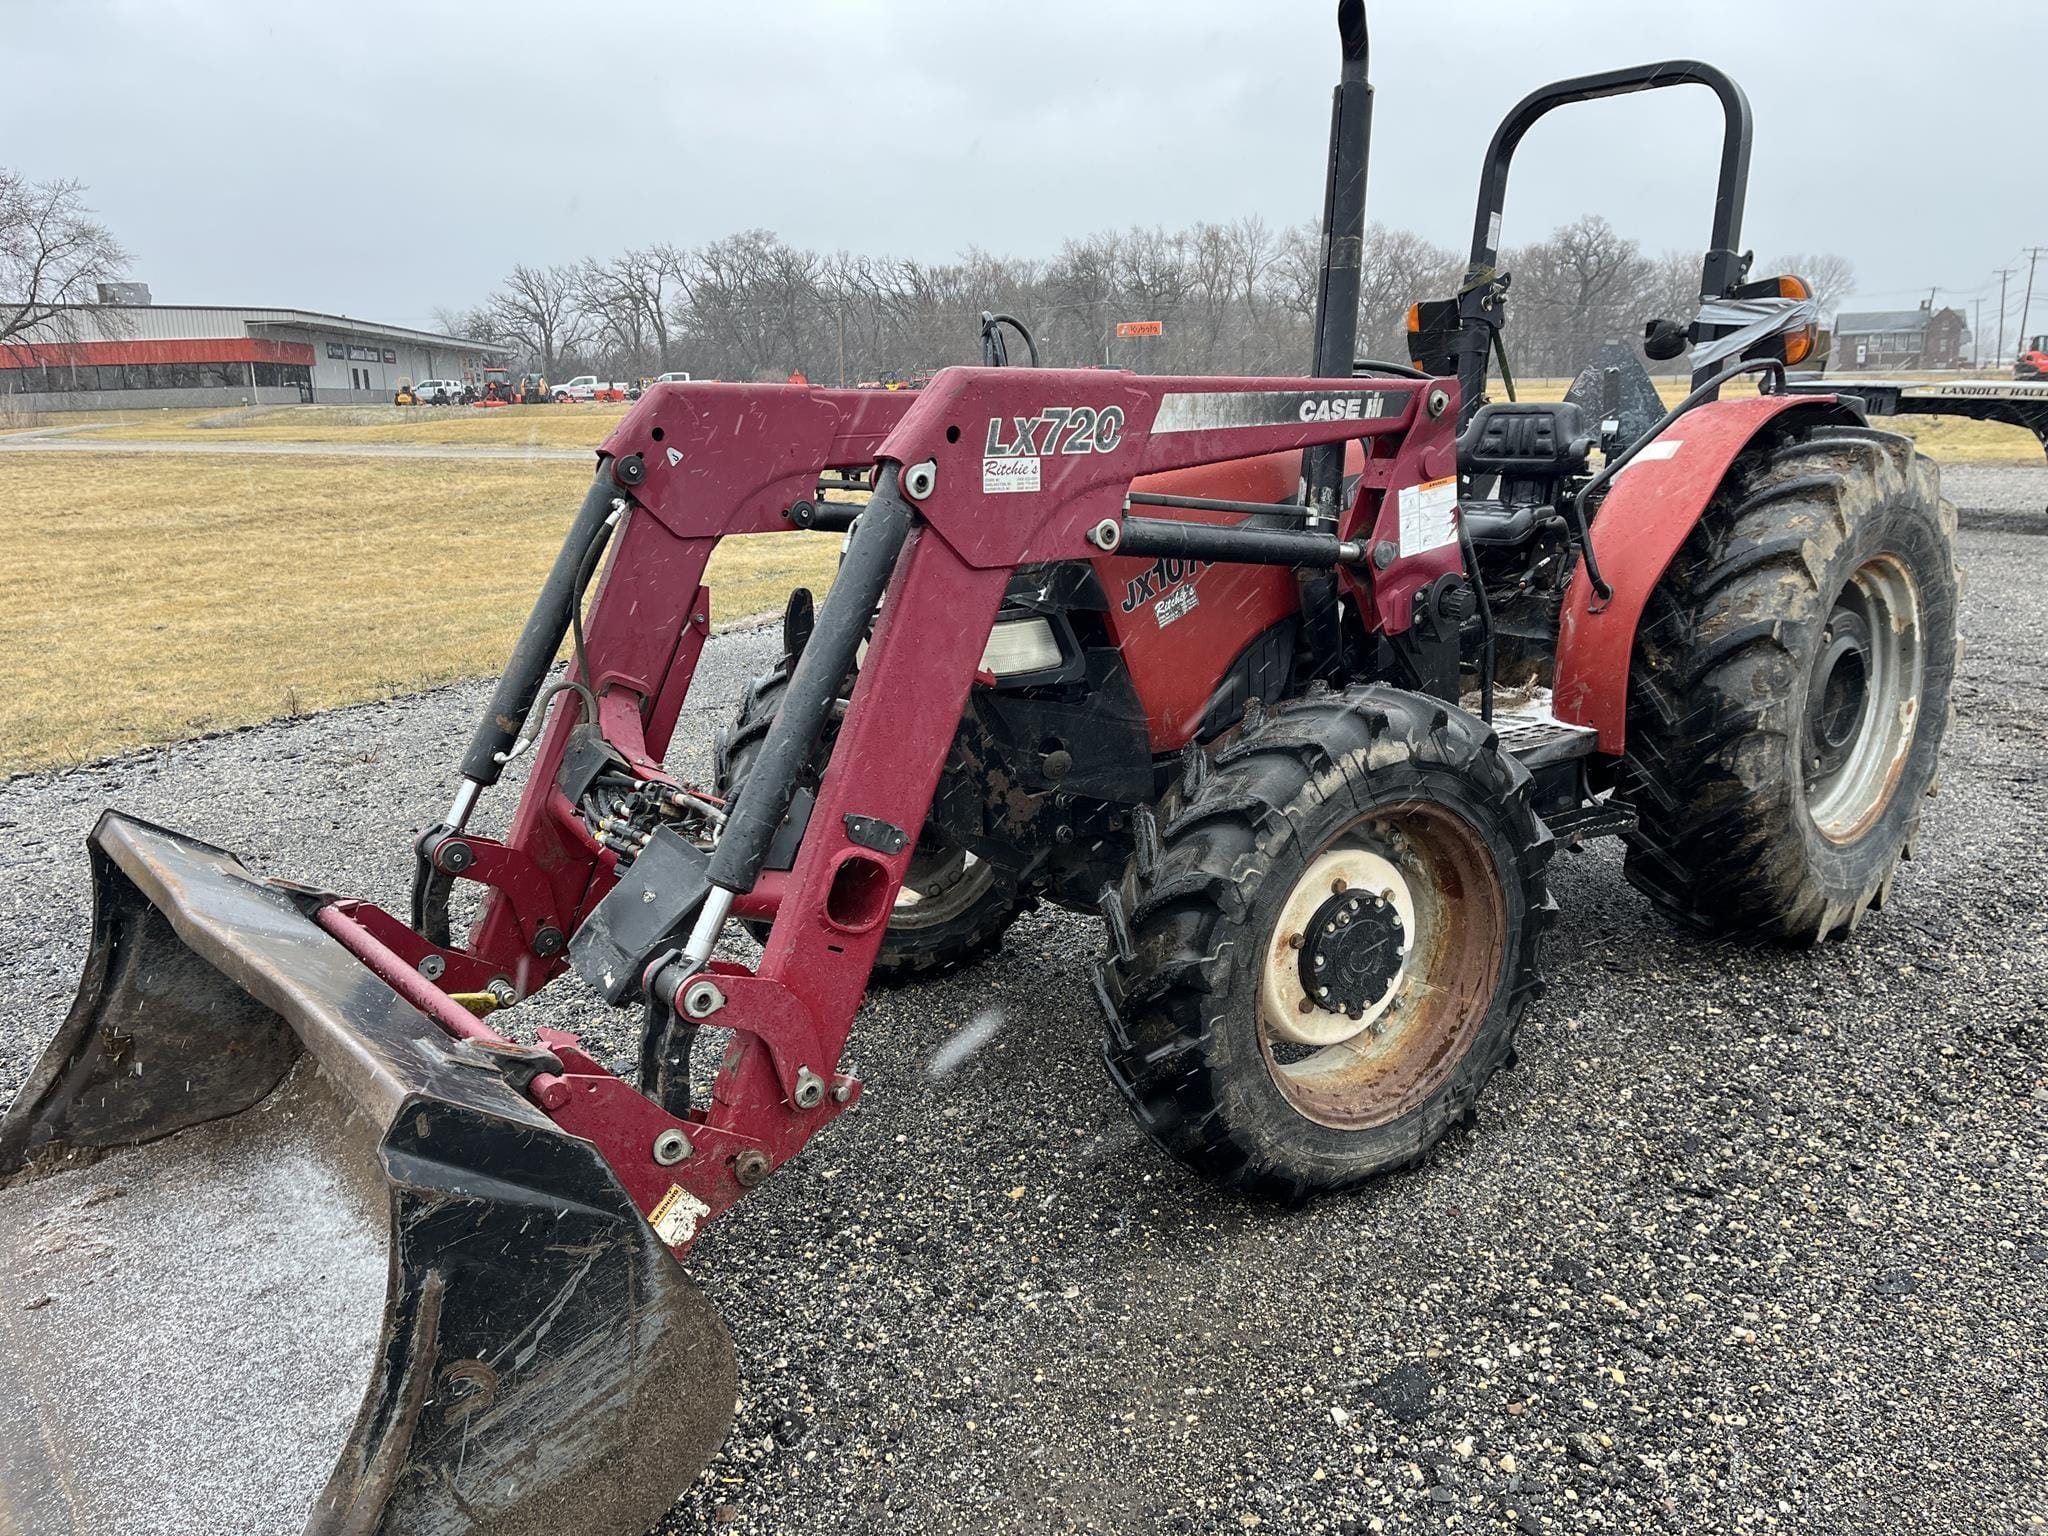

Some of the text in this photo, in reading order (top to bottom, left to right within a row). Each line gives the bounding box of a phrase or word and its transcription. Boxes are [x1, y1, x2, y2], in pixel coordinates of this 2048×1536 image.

[1940, 386, 2048, 397] LANDOLL HAUL
[1299, 399, 1361, 421] CASE
[984, 405, 1125, 457] LX720
[984, 459, 1038, 476] Ritchie's
[1121, 556, 1216, 613] JX10
[653, 1189, 679, 1221] WARNING
